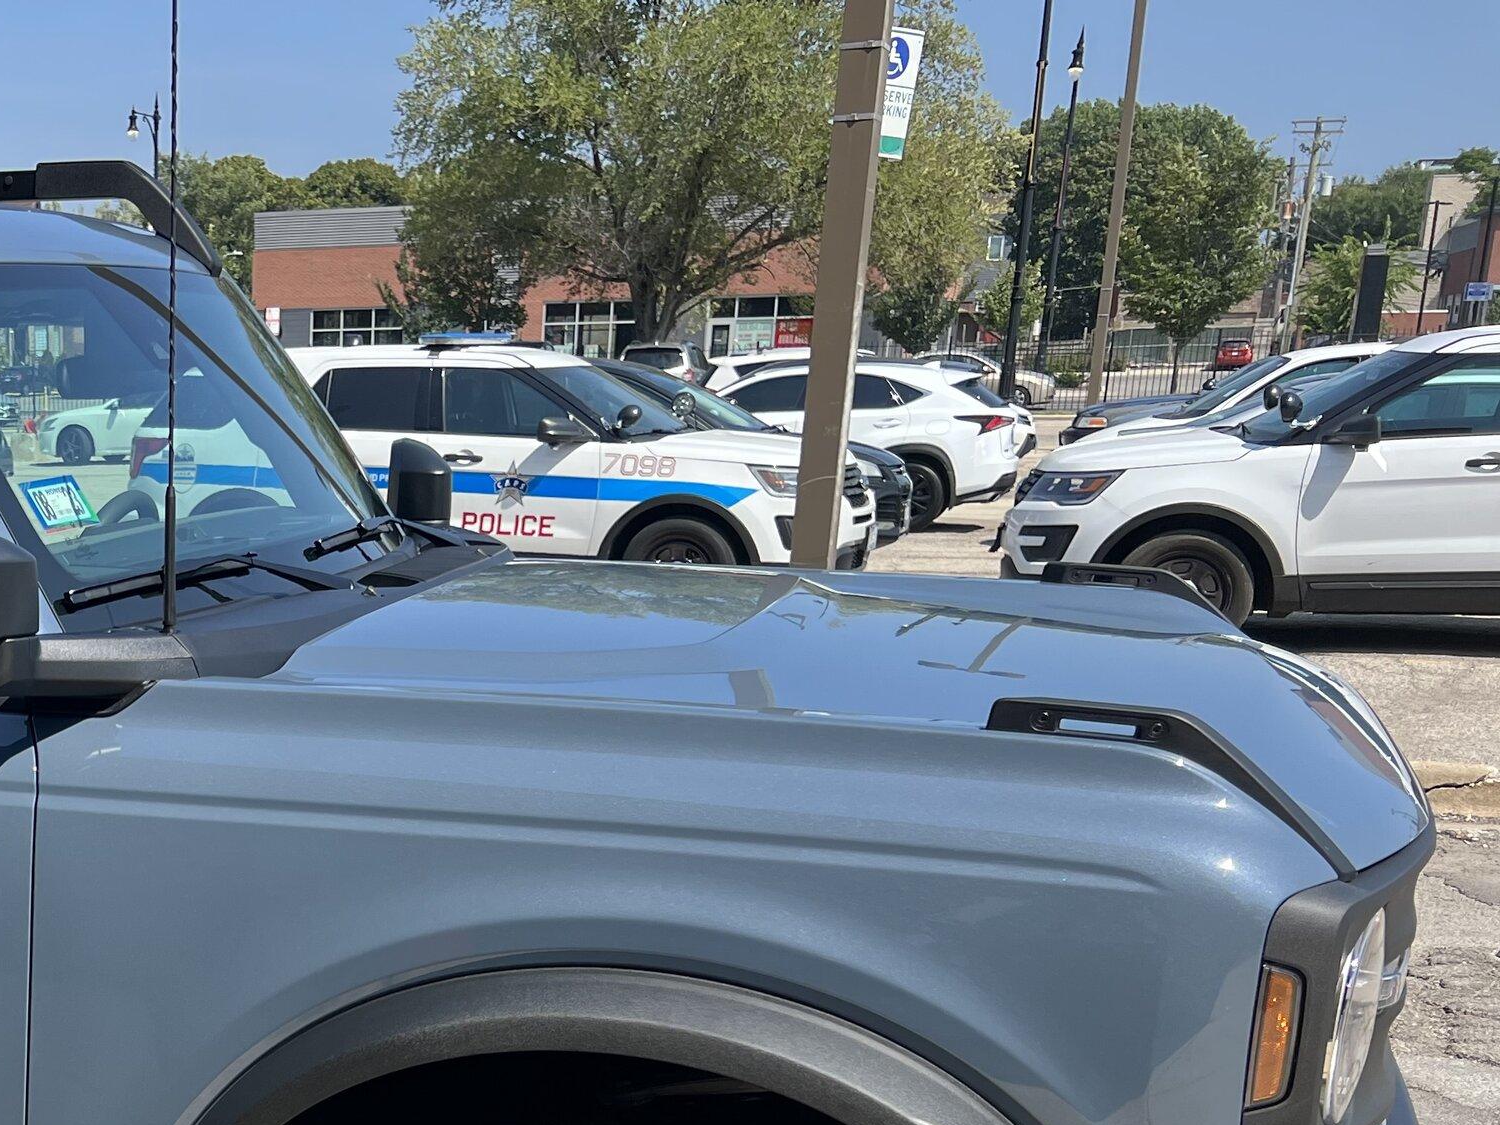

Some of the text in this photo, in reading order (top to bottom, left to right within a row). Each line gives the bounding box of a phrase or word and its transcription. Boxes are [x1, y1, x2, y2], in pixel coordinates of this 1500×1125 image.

[884, 90, 913, 105] SERVE
[602, 453, 677, 478] 7098
[496, 477, 527, 491] CAPS
[461, 511, 556, 538] POLICE
